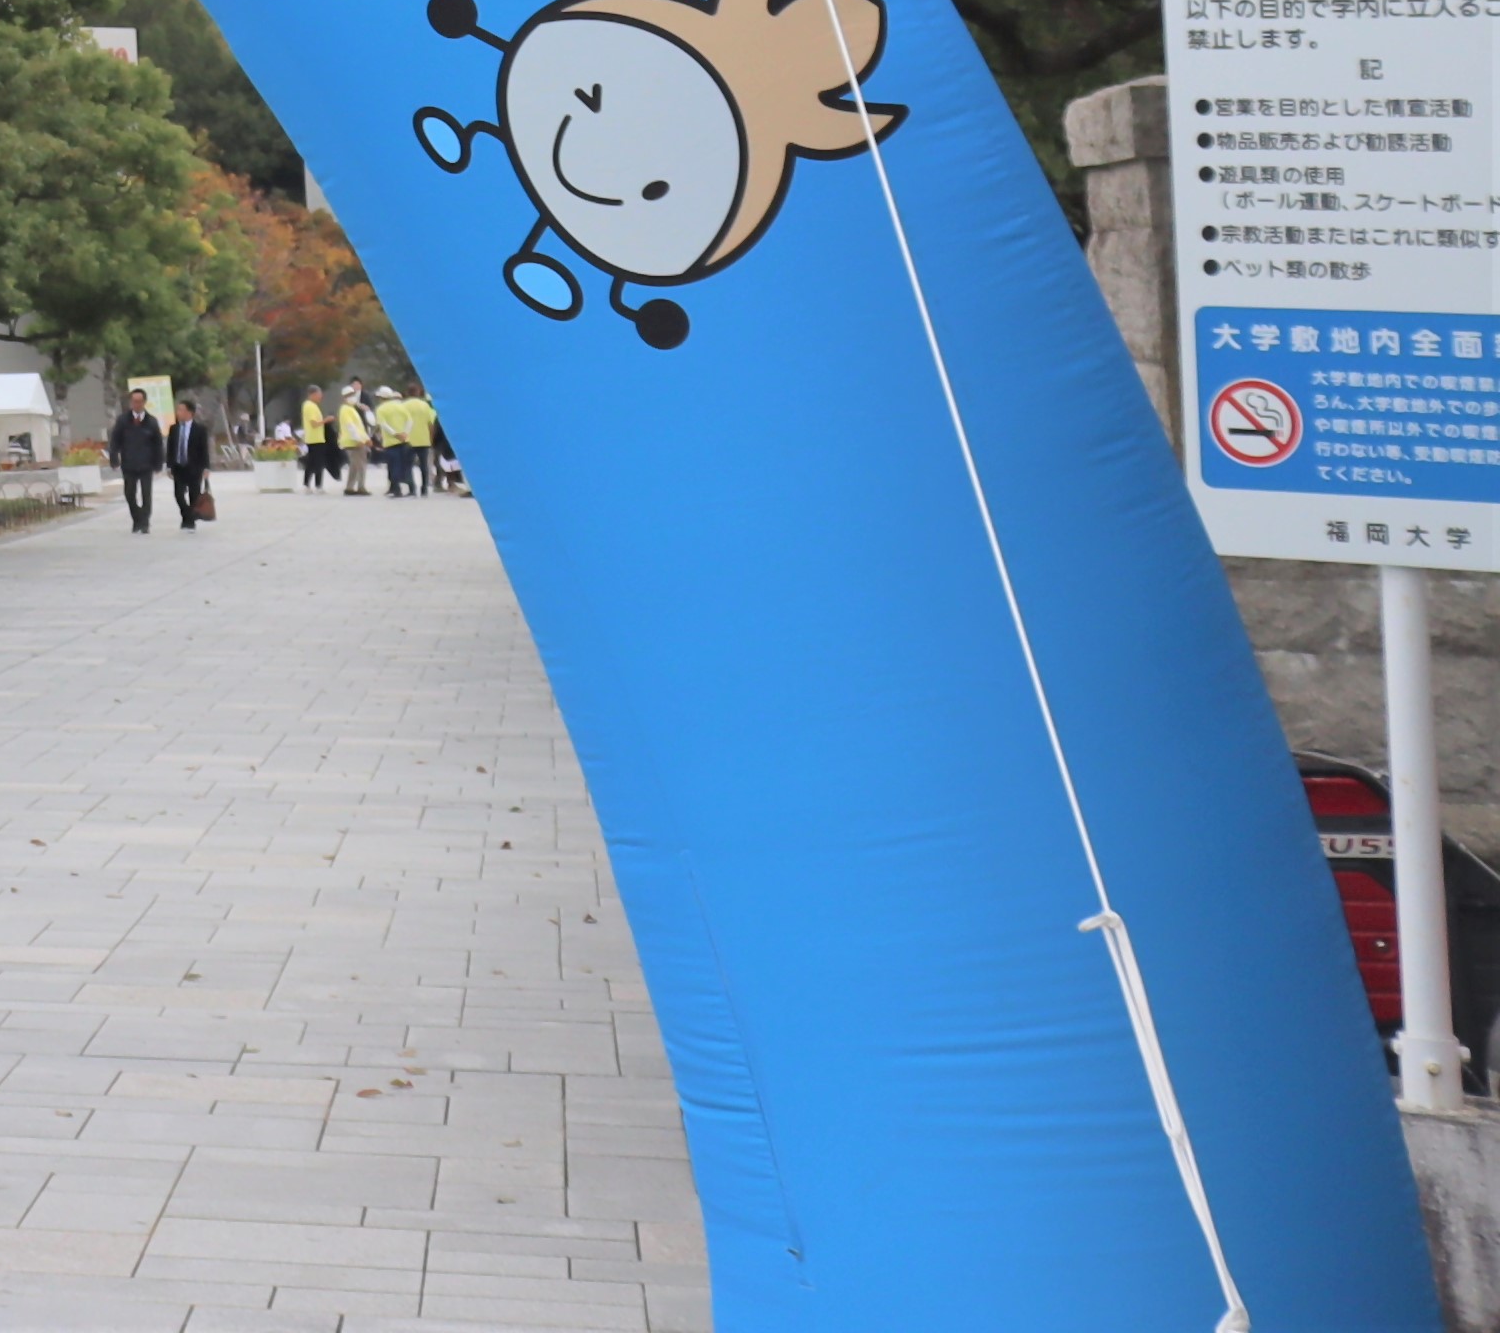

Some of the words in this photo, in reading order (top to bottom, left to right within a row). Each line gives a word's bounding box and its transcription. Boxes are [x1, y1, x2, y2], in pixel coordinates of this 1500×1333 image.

[1187, 29, 1320, 50] 禁止します。
[1358, 59, 1384, 80] 記
[1216, 132, 1453, 152] 物品販売および勧誘活動
[1218, 166, 1346, 186] 遊具類の使用
[1223, 260, 1373, 280] ペット類の散歩
[1212, 324, 1500, 358] 大学敷地内全面
[1317, 466, 1413, 484] てください。
[1326, 520, 1473, 550] 福岡大学
